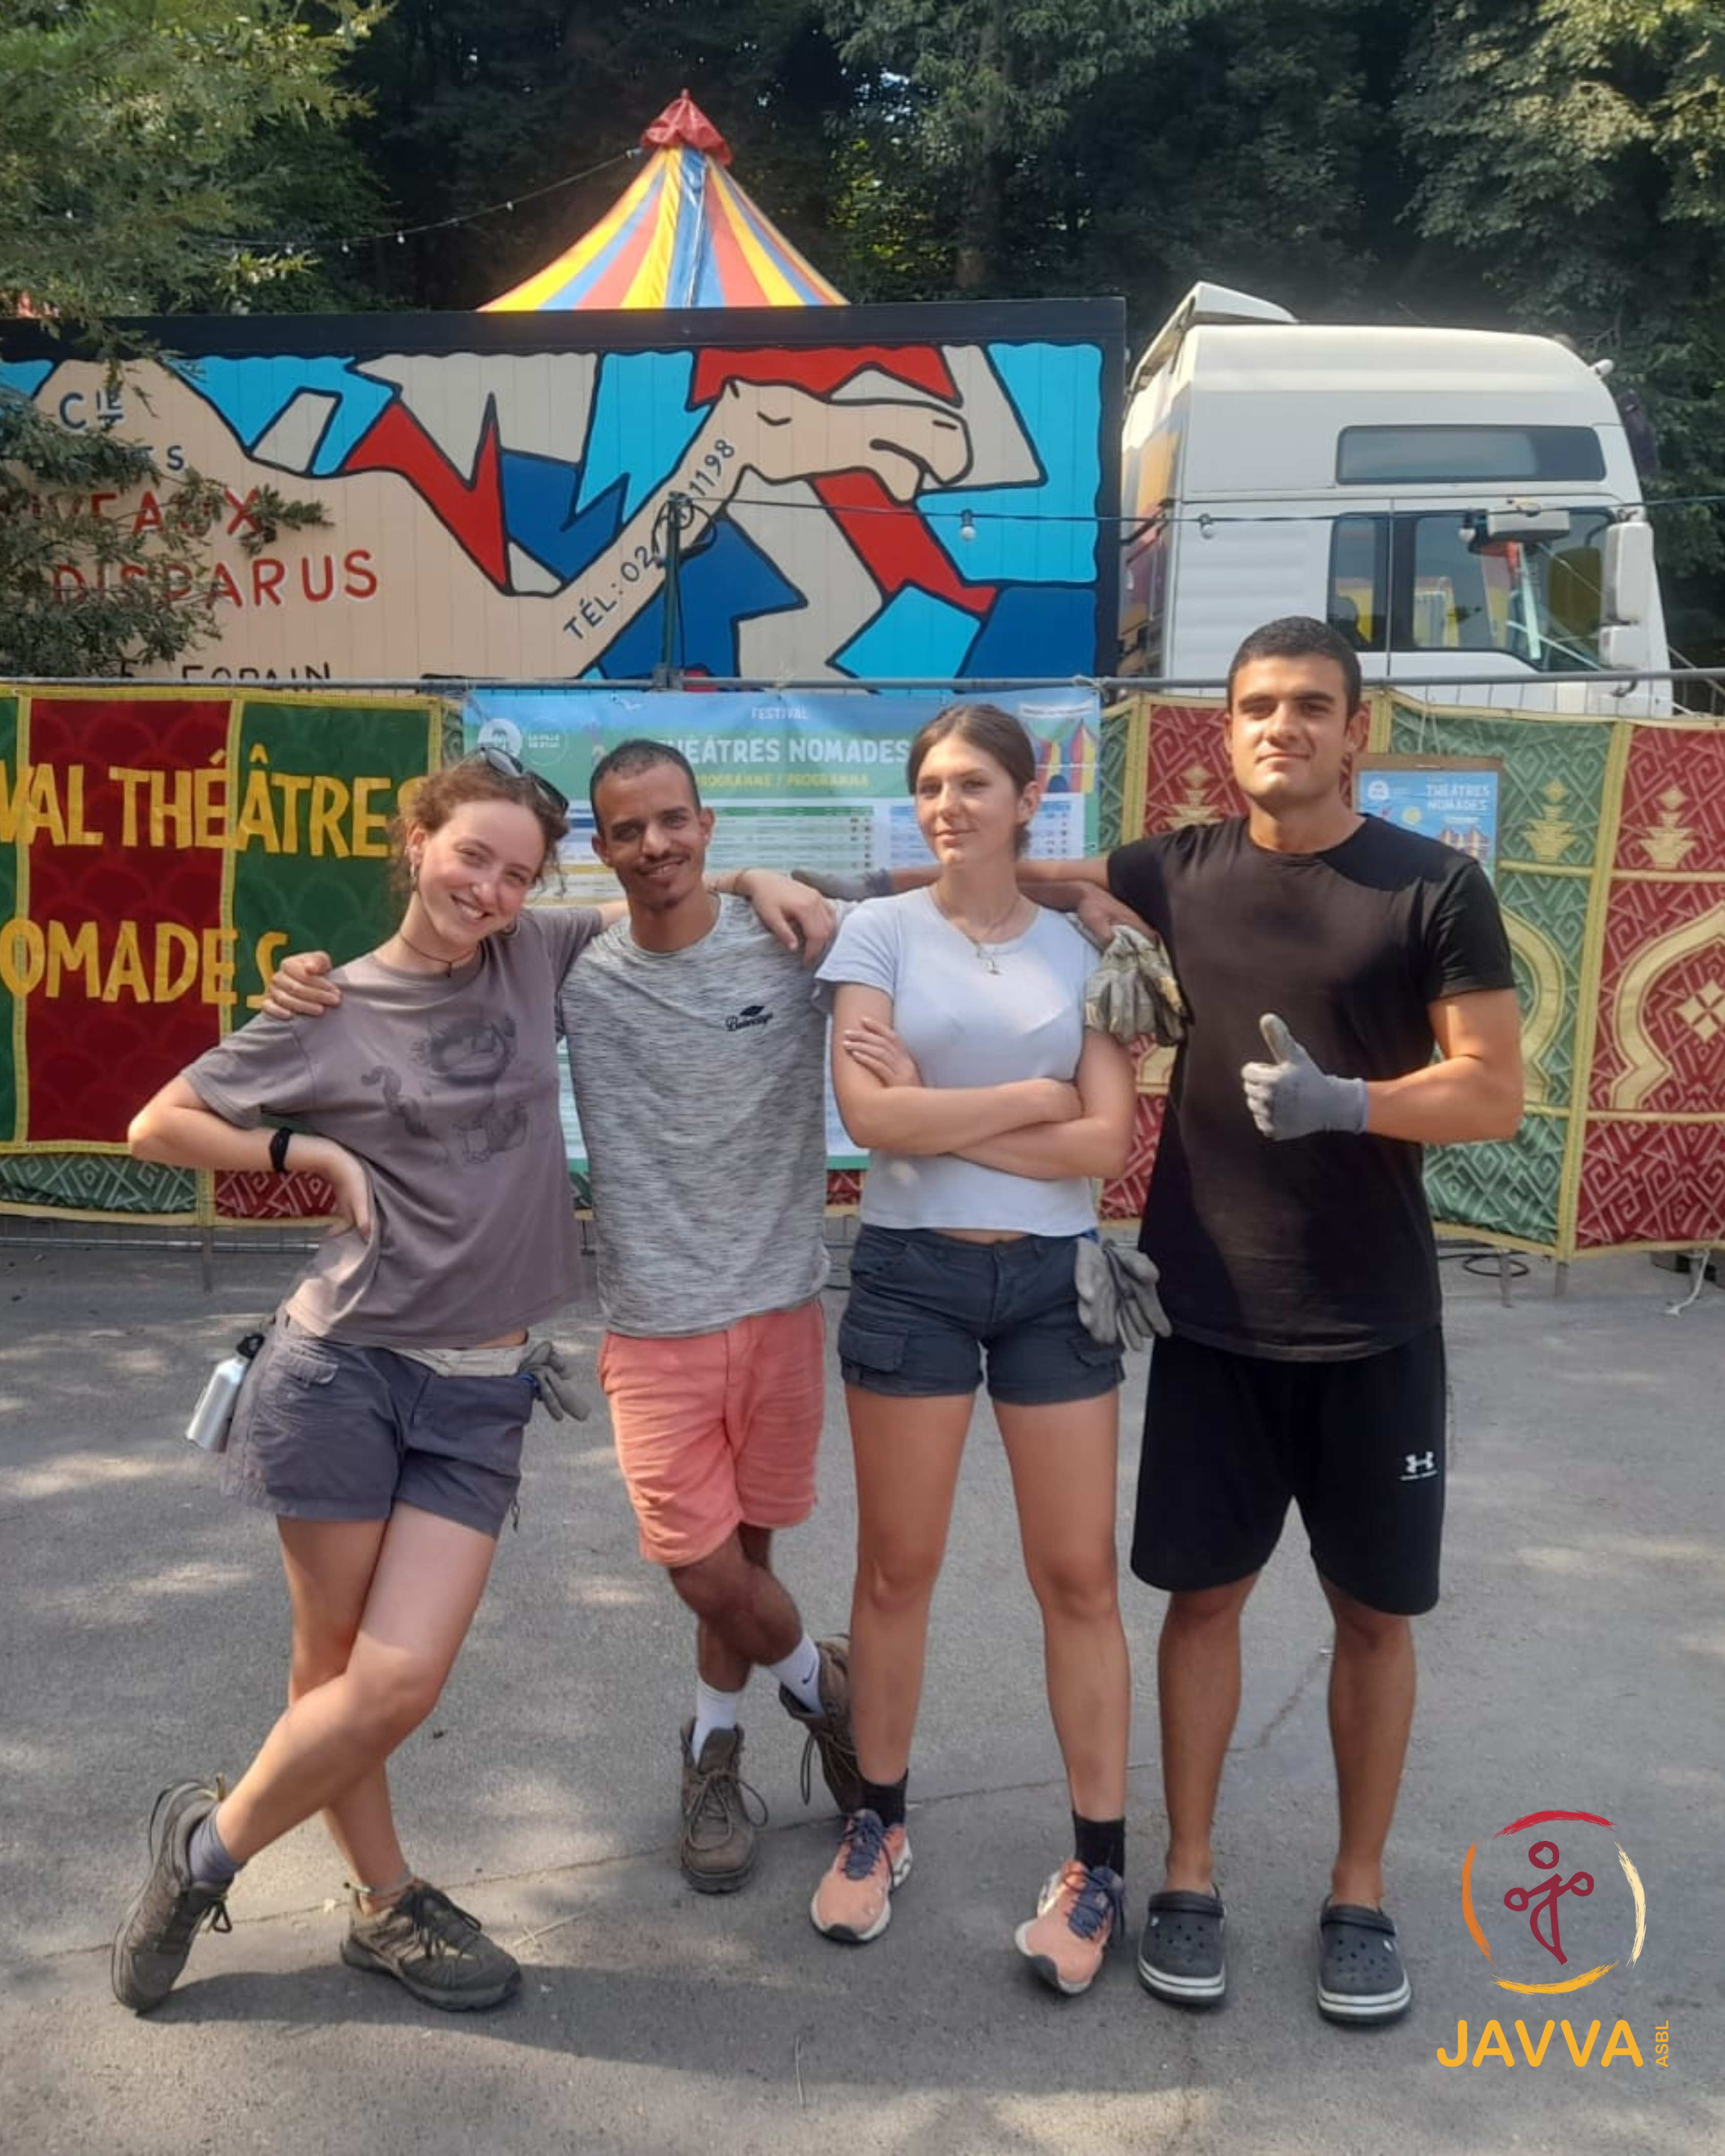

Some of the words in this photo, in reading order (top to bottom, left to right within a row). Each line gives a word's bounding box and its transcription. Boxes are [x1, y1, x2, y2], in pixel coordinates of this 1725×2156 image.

[751, 707, 808, 720] FESTIVAL
[789, 739, 909, 763] NOMADES
[109, 744, 432, 858] THÉÂTRE
